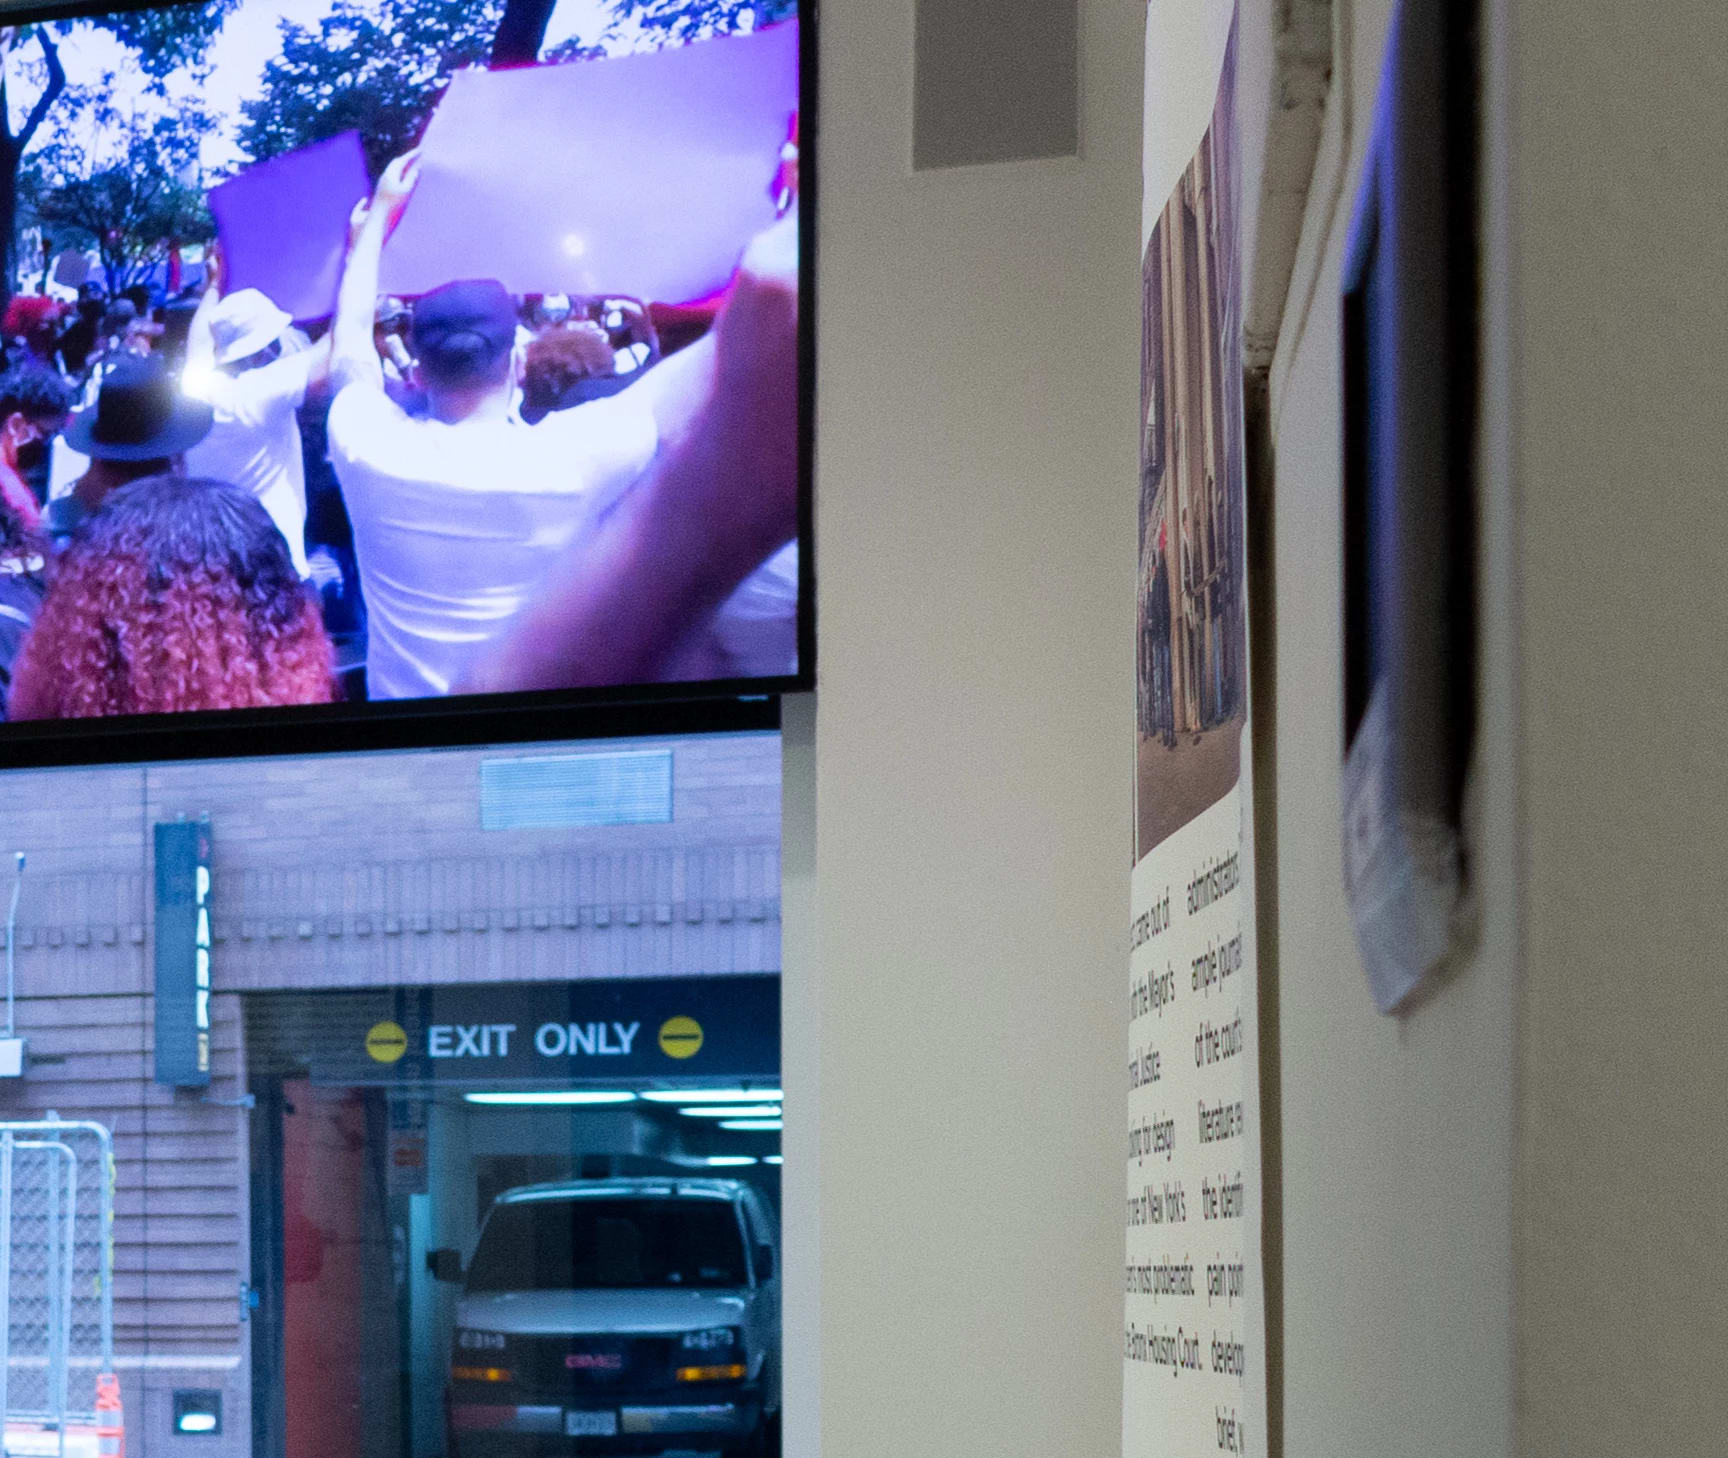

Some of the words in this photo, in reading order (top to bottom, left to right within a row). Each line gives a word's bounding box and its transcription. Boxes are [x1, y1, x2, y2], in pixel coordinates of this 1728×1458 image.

[196, 865, 211, 1030] PARK
[427, 1024, 517, 1057] EXIT
[534, 1022, 640, 1056] ONLY
